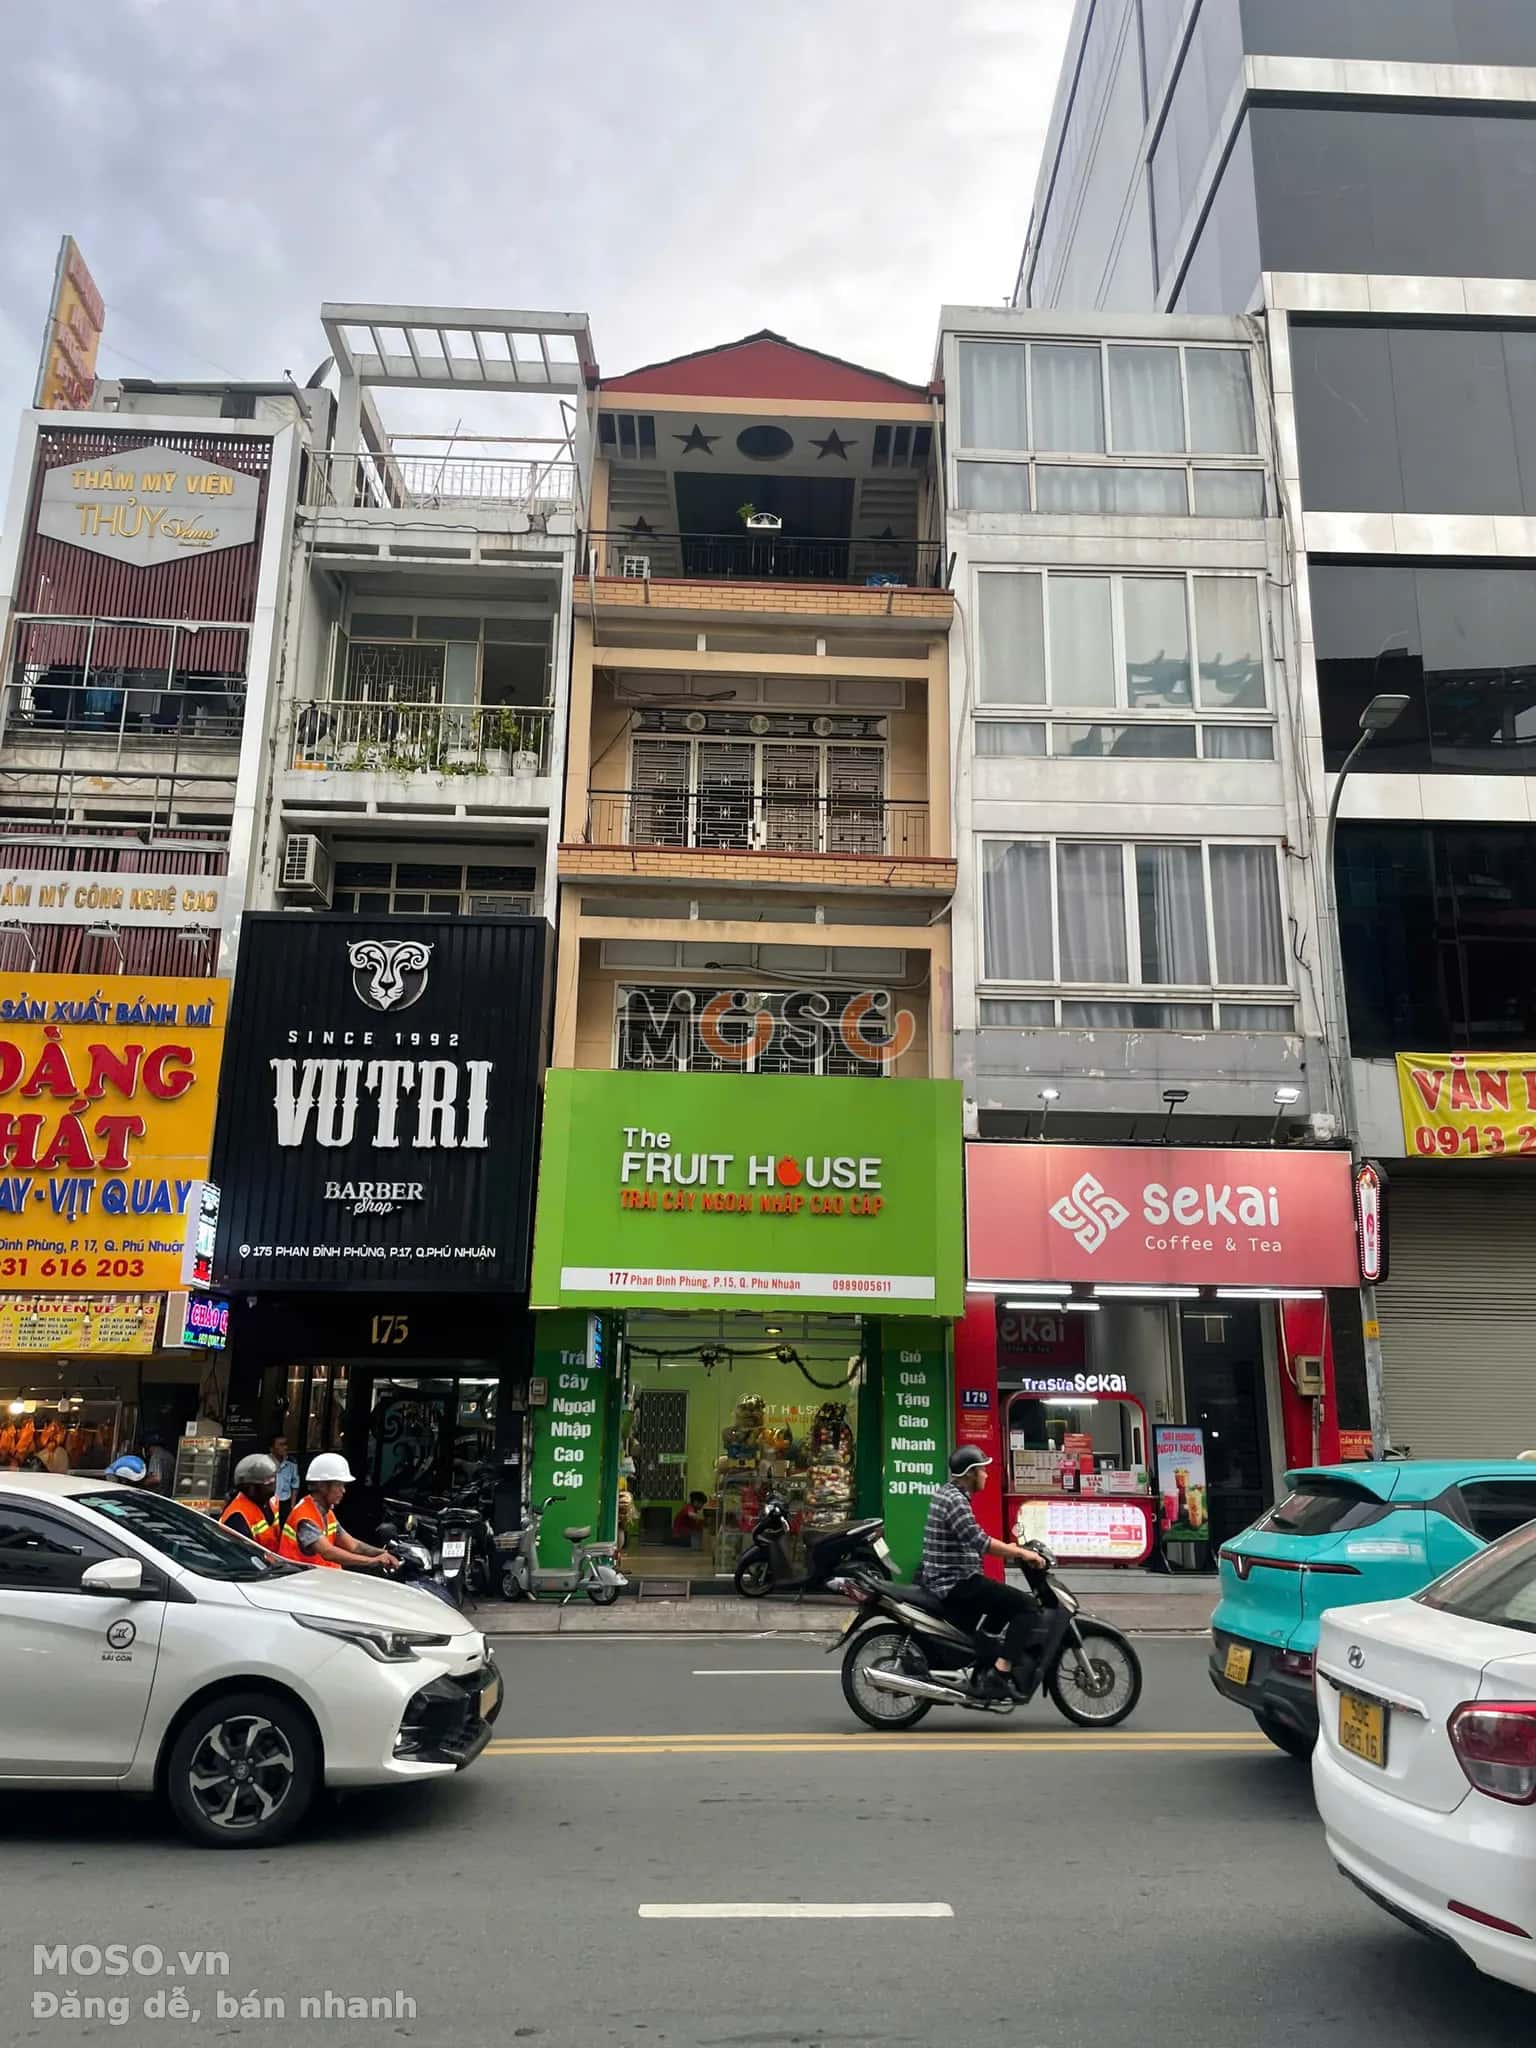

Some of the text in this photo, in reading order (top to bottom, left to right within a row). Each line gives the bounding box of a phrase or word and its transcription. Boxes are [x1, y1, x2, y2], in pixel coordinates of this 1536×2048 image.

[141, 470, 178, 493] MỸ
[185, 472, 235, 500] VIỆN
[75, 496, 169, 538] THỦY
[38, 882, 70, 908] MỸ
[74, 882, 124, 909] CÔNG
[129, 885, 177, 915] NGHỆ
[182, 888, 218, 912] CAO
[0, 990, 216, 1026] SẢN XUẤT BÁNH MÌ
[287, 1030, 460, 1046] SINCE 1992
[1411, 1056, 1512, 1112] VĂN
[269, 1058, 494, 1147] VUTRI
[622, 1128, 672, 1149] The
[1415, 1125, 1505, 1154] 0913
[621, 1152, 734, 1186] FRUIT
[101, 1178, 192, 1216] QUAY
[324, 1181, 424, 1200] BARBER
[353, 1198, 394, 1215] Shop
[809, 1194, 845, 1215] CAO
[103, 1240, 118, 1252] Q.
[122, 1239, 144, 1252] Phú
[253, 1246, 273, 1257] 175
[275, 1246, 310, 1257] PHAN
[312, 1244, 341, 1257] ĐÌNH
[343, 1244, 387, 1259] PHÙNG,
[454, 1245, 496, 1260] NHUẬN
[1145, 1236, 1282, 1253] Coffee & Tea
[40, 1258, 87, 1277] 616
[96, 1259, 145, 1277] 203
[609, 1272, 629, 1285] 177
[630, 1275, 653, 1286] Phan
[372, 1315, 408, 1344] 175
[561, 1349, 586, 1365] Trá
[559, 1373, 589, 1391] Cây
[896, 1393, 930, 1408] Tặng
[965, 1391, 988, 1403] 179
[552, 1398, 596, 1417] Ngoại
[899, 1414, 929, 1428] Giao
[551, 1422, 592, 1440] Nhập
[891, 1437, 936, 1451] Nhanh
[554, 1446, 584, 1461] Cao
[893, 1460, 933, 1475] Trong
[552, 1469, 583, 1488] Cấp
[889, 1481, 907, 1494] 30
